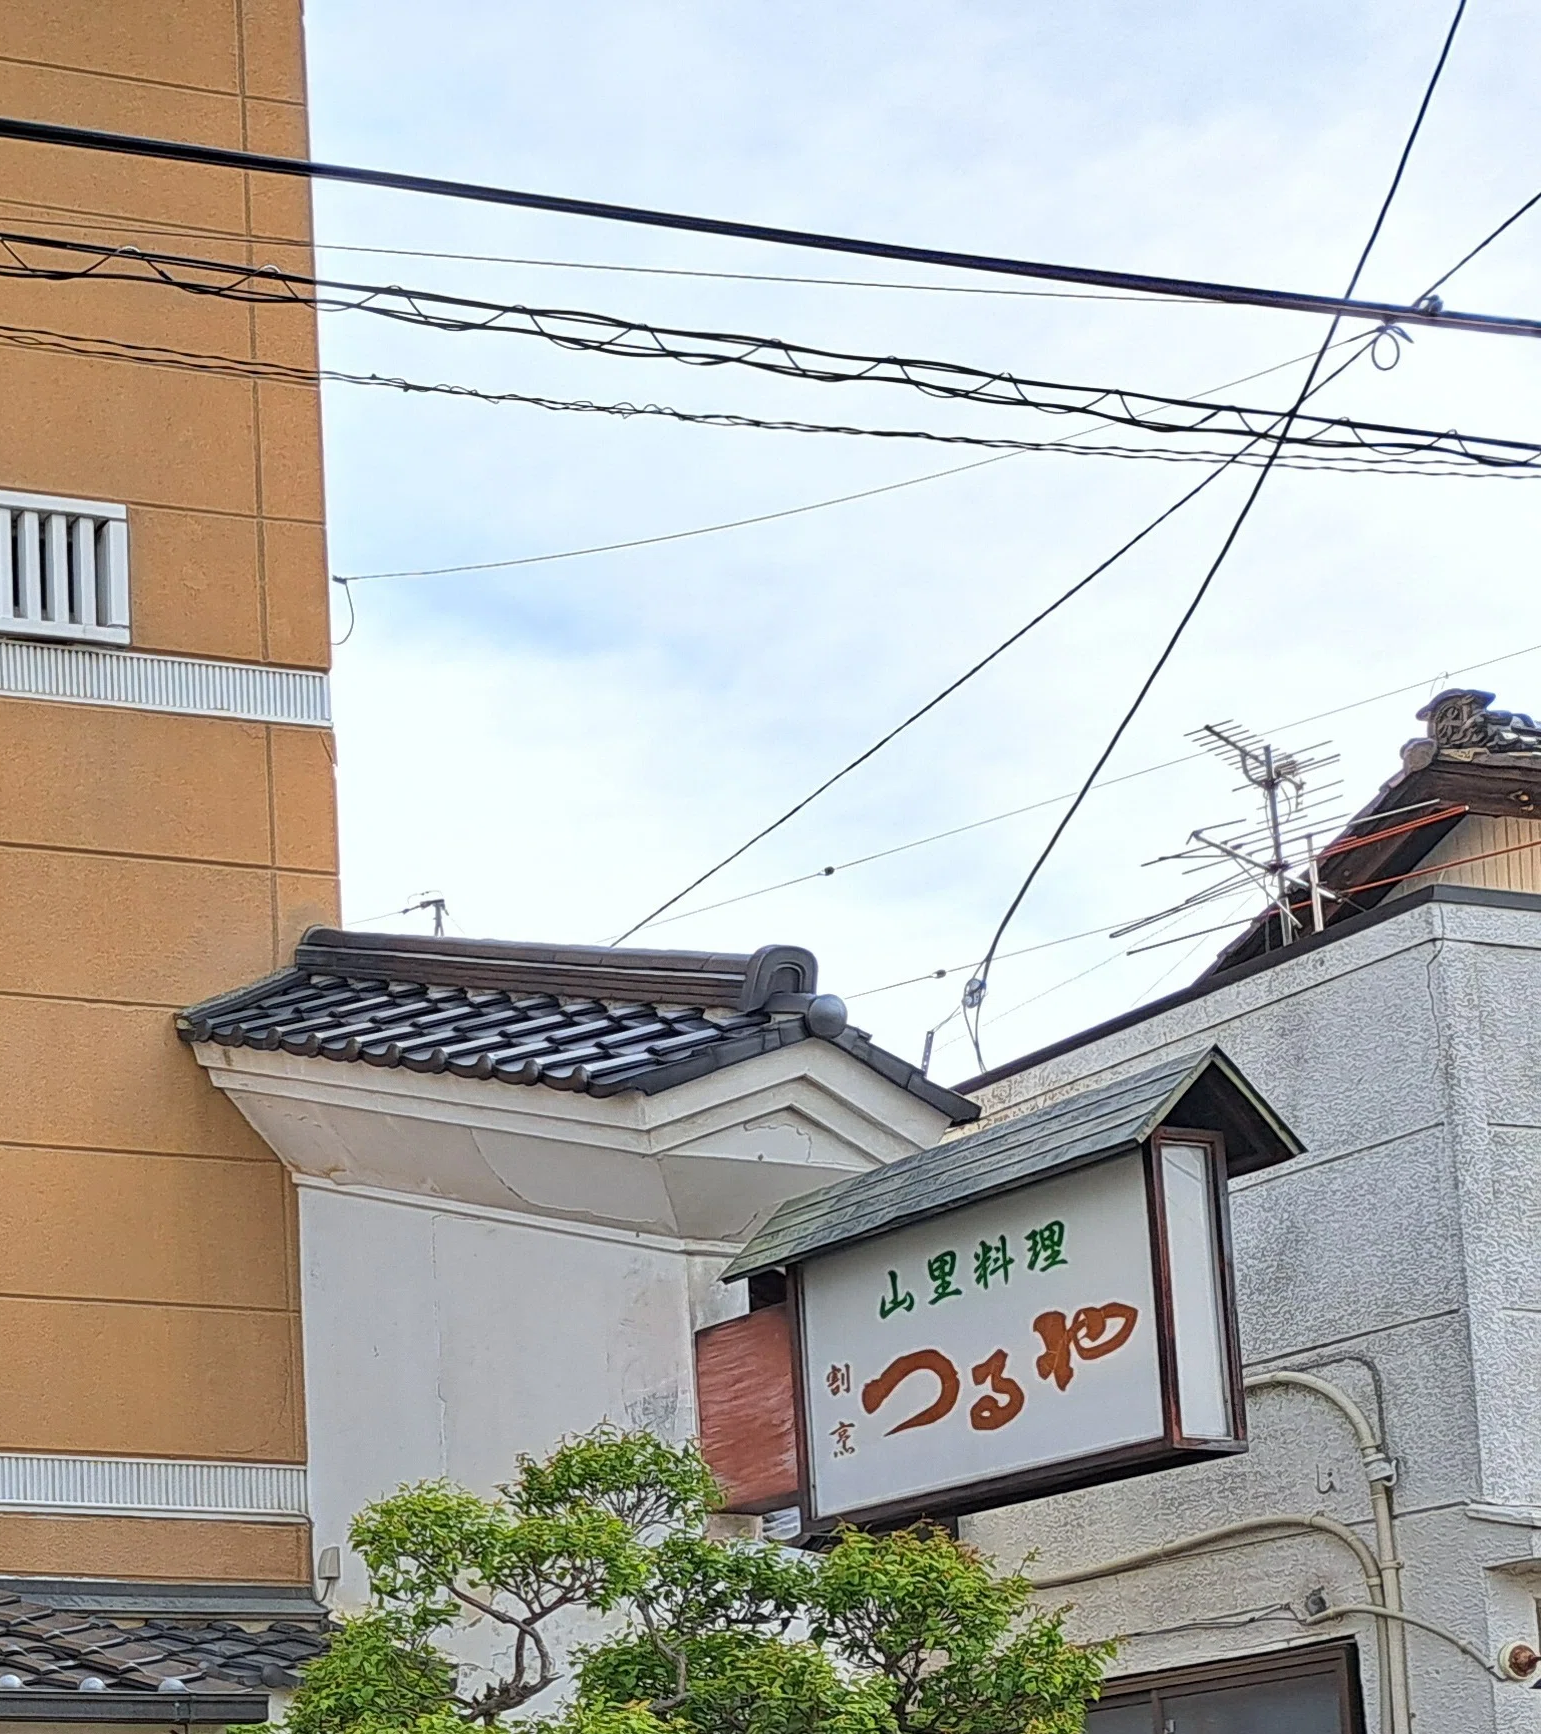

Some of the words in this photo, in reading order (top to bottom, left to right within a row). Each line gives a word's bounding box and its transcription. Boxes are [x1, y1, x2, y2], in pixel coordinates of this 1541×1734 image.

[877, 1219, 1068, 1320] 山里料理
[861, 1301, 1139, 1436] つるや
